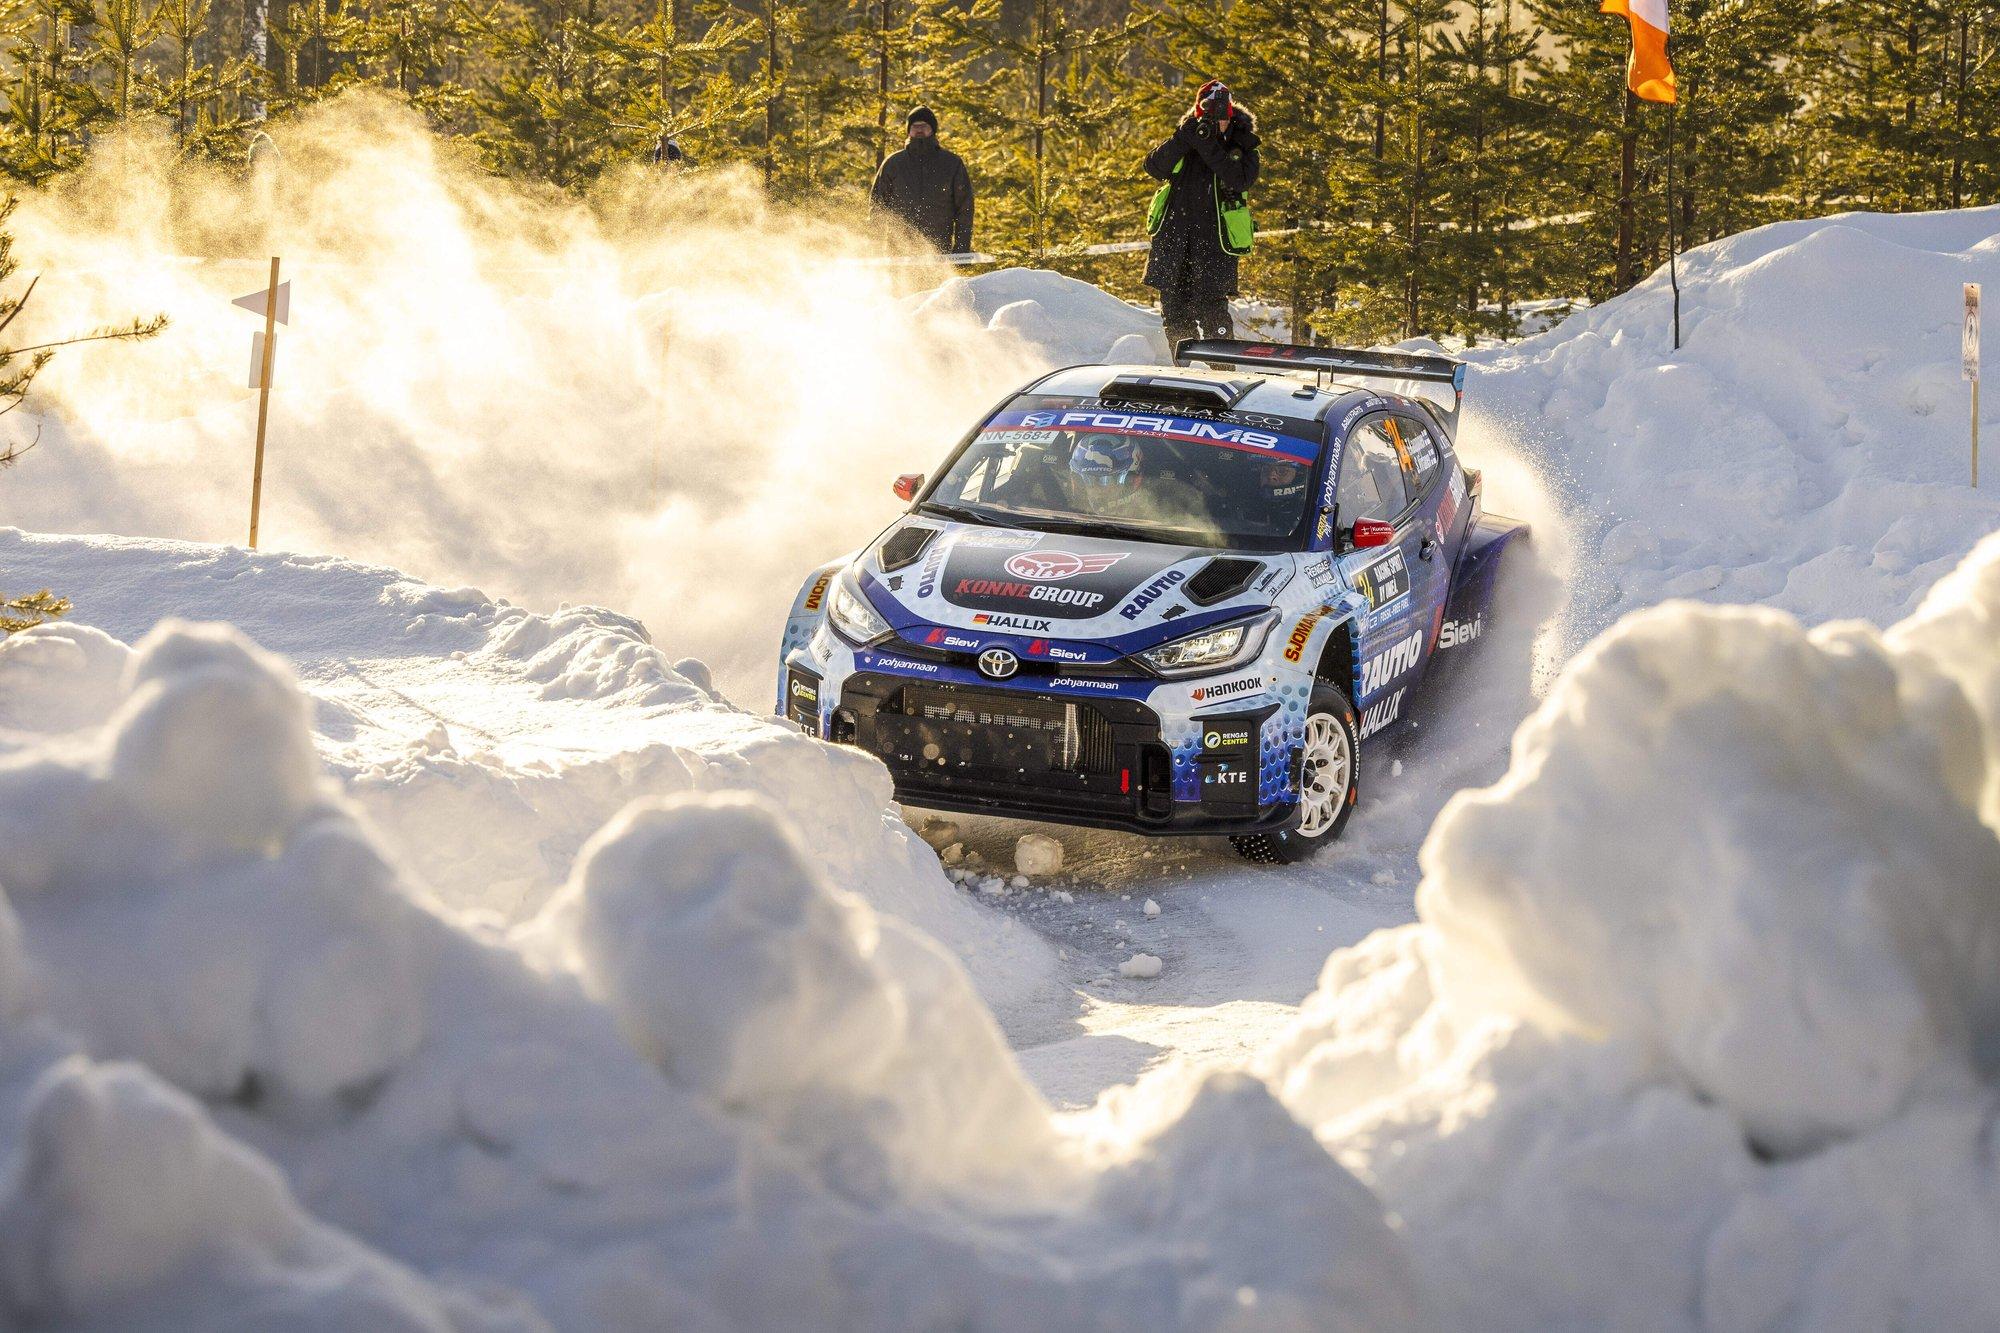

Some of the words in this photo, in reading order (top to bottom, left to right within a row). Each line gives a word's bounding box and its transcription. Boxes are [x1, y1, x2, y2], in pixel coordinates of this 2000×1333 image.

[1181, 412, 1241, 424] ATTORNEYS
[1219, 410, 1240, 419] &
[1245, 413, 1284, 426] CO
[981, 431, 1051, 441] NN-5684
[1060, 412, 1279, 450] FORUM8
[1322, 436, 1342, 505] pohjanmaan
[917, 542, 948, 599] AUTIO
[954, 578, 1104, 608] KONNEGROUP
[1119, 569, 1186, 621] RAUTIO
[986, 614, 1052, 632] HALLIX
[1438, 612, 1481, 649] Sievi
[944, 635, 980, 649] Sievi
[1050, 648, 1086, 661] Sievi
[878, 657, 938, 673] pohjanmaan
[1053, 677, 1119, 690] pohjanmaan
[1360, 685, 1407, 740] HALLIX
[1222, 731, 1249, 740] RENGAS
[1222, 737, 1248, 746] CENTER
[1217, 771, 1247, 784] KTE
